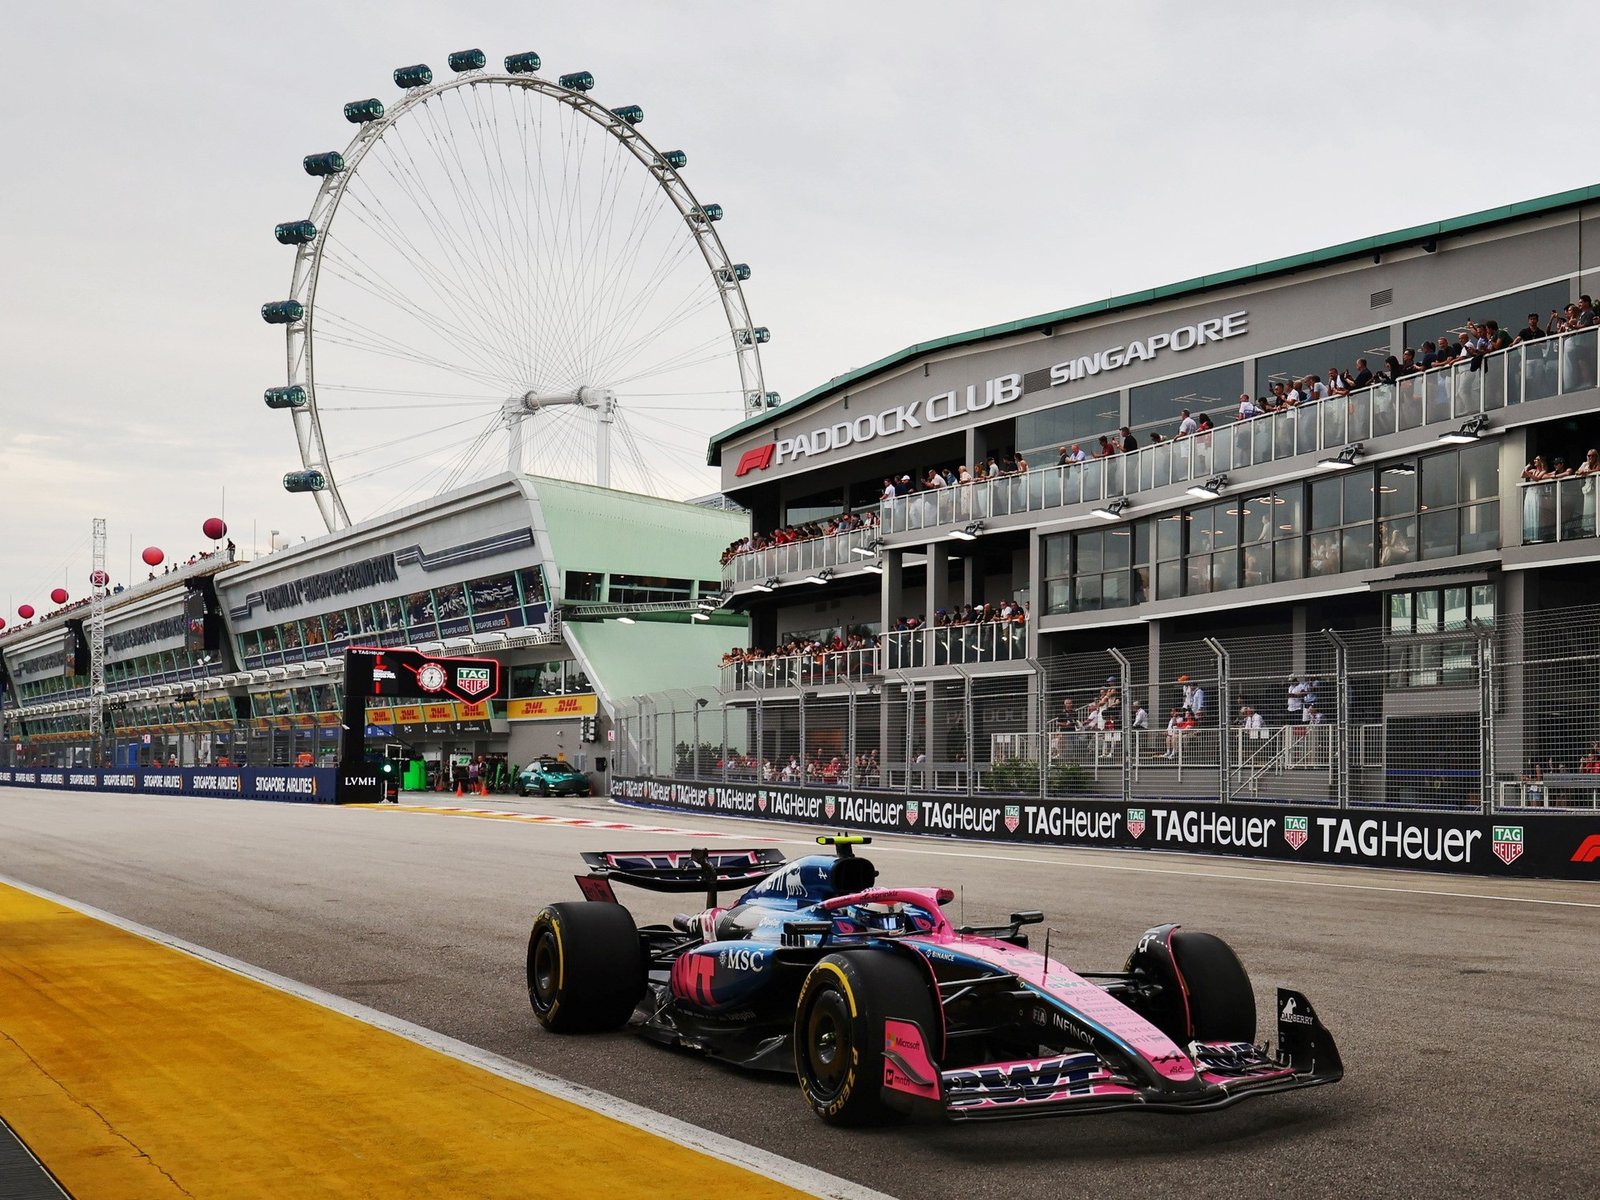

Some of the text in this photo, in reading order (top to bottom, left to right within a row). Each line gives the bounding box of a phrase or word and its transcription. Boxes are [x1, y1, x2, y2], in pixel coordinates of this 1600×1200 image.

[1050, 311, 1248, 387] SINGAPORE
[775, 399, 922, 465] PADDOCK
[925, 373, 1023, 422] CLUB
[461, 669, 487, 678] TAG
[459, 679, 488, 694] HEUER
[193, 776, 237, 790] SINGAPORE AIRLINES
[256, 776, 312, 793] SINGAPORE AIRLINES
[345, 777, 376, 786] LVMH
[677, 784, 708, 806] TAGHeuer
[716, 784, 756, 810] TAGHeuer
[770, 792, 822, 818] TAGHeuer
[838, 797, 903, 826] TAGHeuer
[922, 802, 1001, 832] TAGHeuer
[1024, 806, 1122, 839] TAGHeuer
[1128, 810, 1144, 821] TAG
[1152, 810, 1276, 848] TAGHeuer
[1286, 818, 1306, 829] TAG
[1495, 828, 1521, 841] TAG
[1316, 817, 1482, 863] TAGHeuer
[1494, 842, 1522, 860] HEUER
[727, 949, 764, 972] MSC
[932, 951, 955, 962] BINANCE
[1053, 1012, 1095, 1046] INFINOX
[896, 1037, 920, 1051] Microsoft
